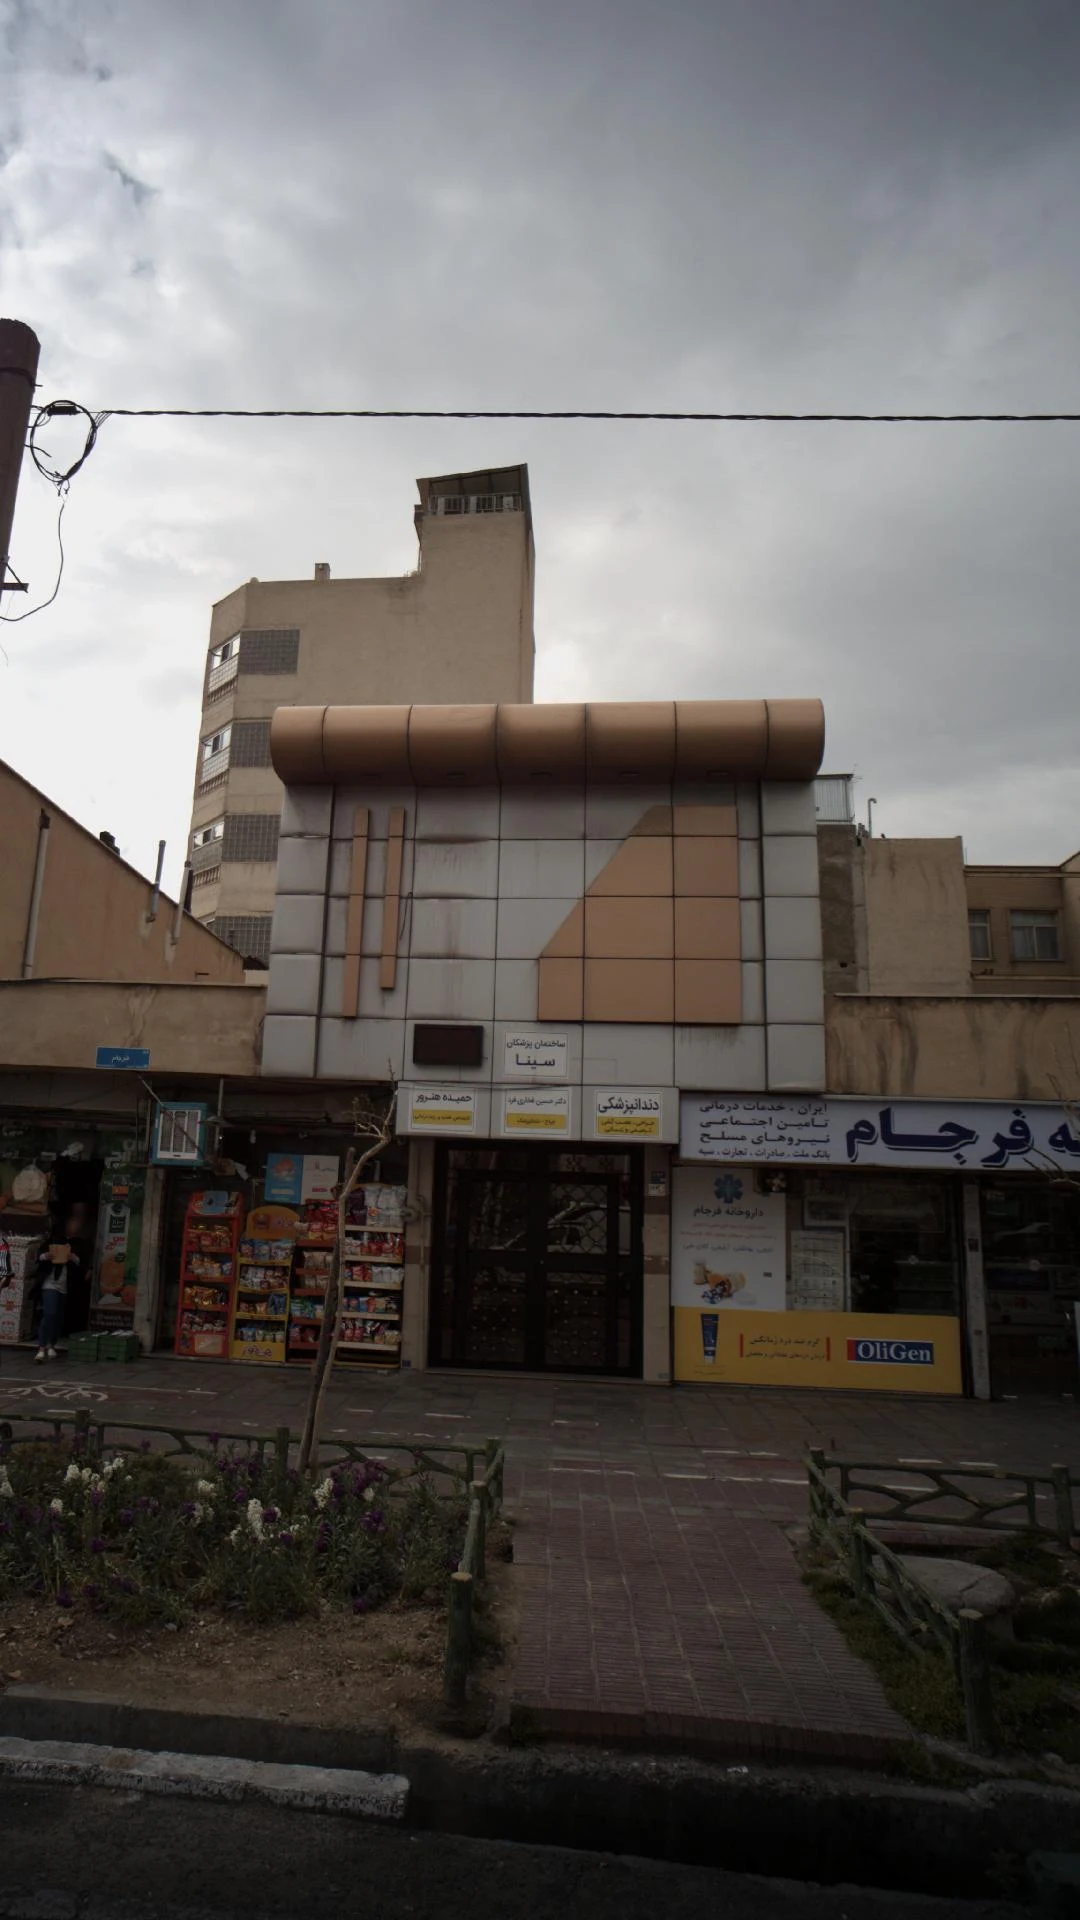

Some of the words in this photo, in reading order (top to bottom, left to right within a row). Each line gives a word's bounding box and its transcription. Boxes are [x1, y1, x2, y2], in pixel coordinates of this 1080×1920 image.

[507, 1038, 533, 1049] پزشکان
[534, 1040, 566, 1049] ساختمان
[516, 1053, 555, 1069] سینا
[442, 1094, 472, 1104] حمیده
[554, 1097, 567, 1107] دکتر
[598, 1096, 659, 1115] دندانپزشکی
[699, 1100, 739, 1112] درمانی
[743, 1101, 785, 1111] خدمات
[797, 1103, 827, 1115] ایران
[700, 1116, 772, 1129] اجتماعی
[700, 1131, 747, 1143] مسلح
[751, 1132, 830, 1146] نیروهای
[847, 1106, 1034, 1168] فرجام
[722, 1148, 747, 1158] تجارت
[755, 1149, 785, 1159] صادرات
[792, 1149, 809, 1158] ملت
[811, 1150, 831, 1160] بانک
[693, 1204, 722, 1217] فرجام
[725, 1206, 764, 1220] داروخانه
[857, 1342, 933, 1363] OliGen
